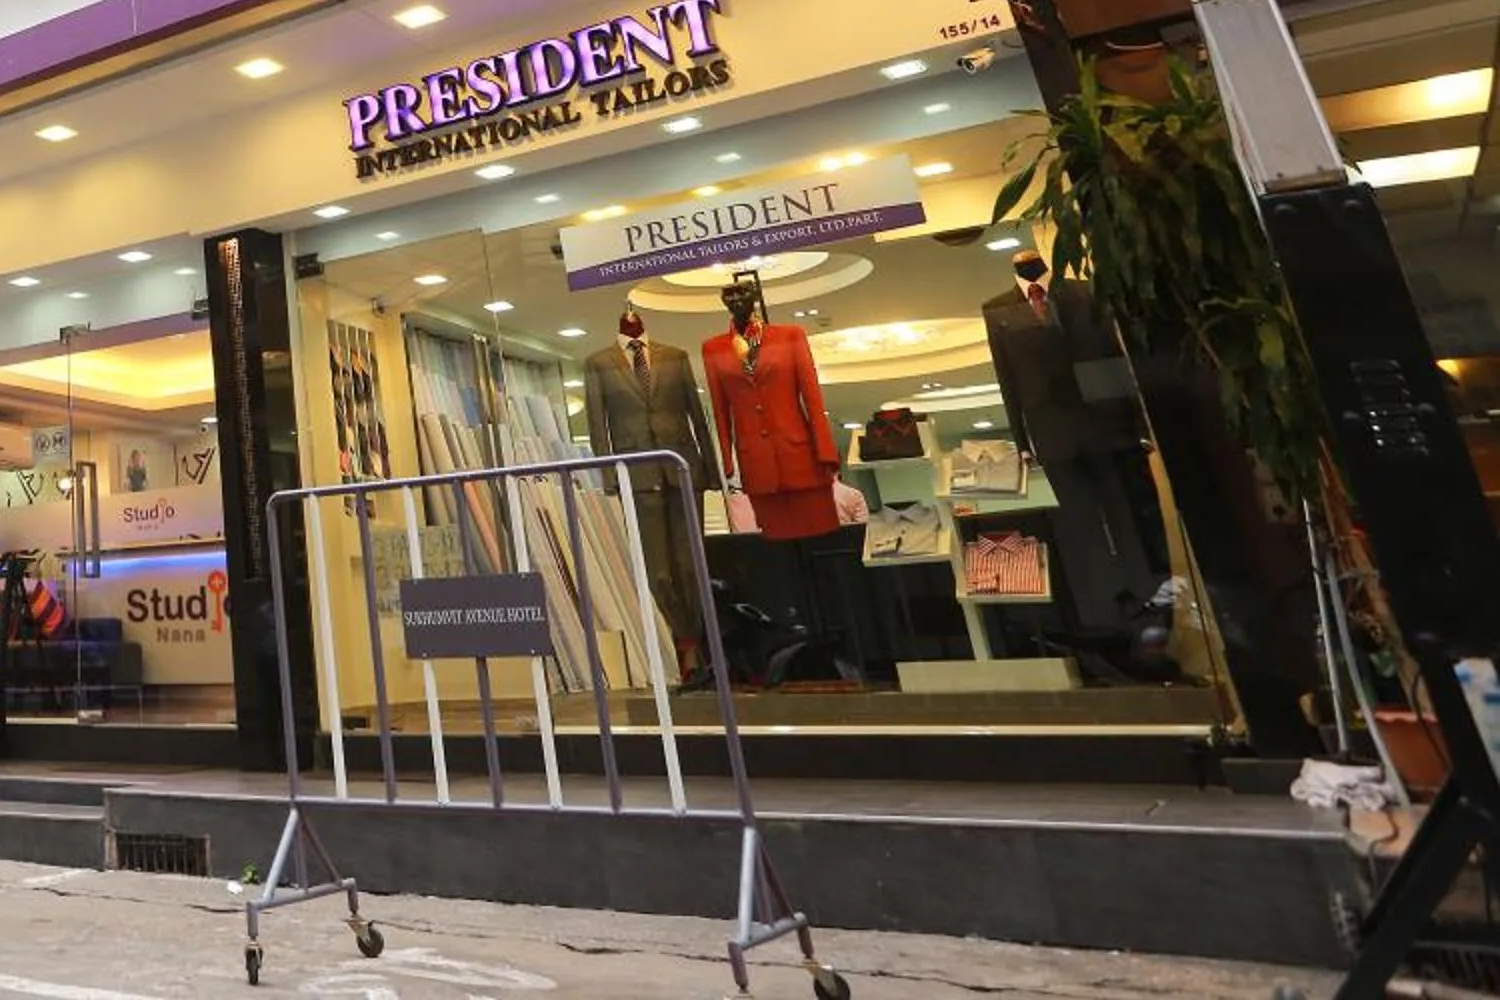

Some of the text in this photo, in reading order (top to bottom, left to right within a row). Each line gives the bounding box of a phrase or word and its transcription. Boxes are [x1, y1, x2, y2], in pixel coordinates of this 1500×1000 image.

[940, 13, 1002, 40] 155/14
[355, 59, 731, 179] INTERNATIONAL TAILORS
[623, 183, 839, 253] PRESIDENT
[600, 250, 697, 277] INTERNATIONAL
[699, 237, 749, 257] TAILORS
[751, 234, 762, 246] &
[507, 606, 545, 623] HOTEL
[156, 628, 206, 644] Nana
